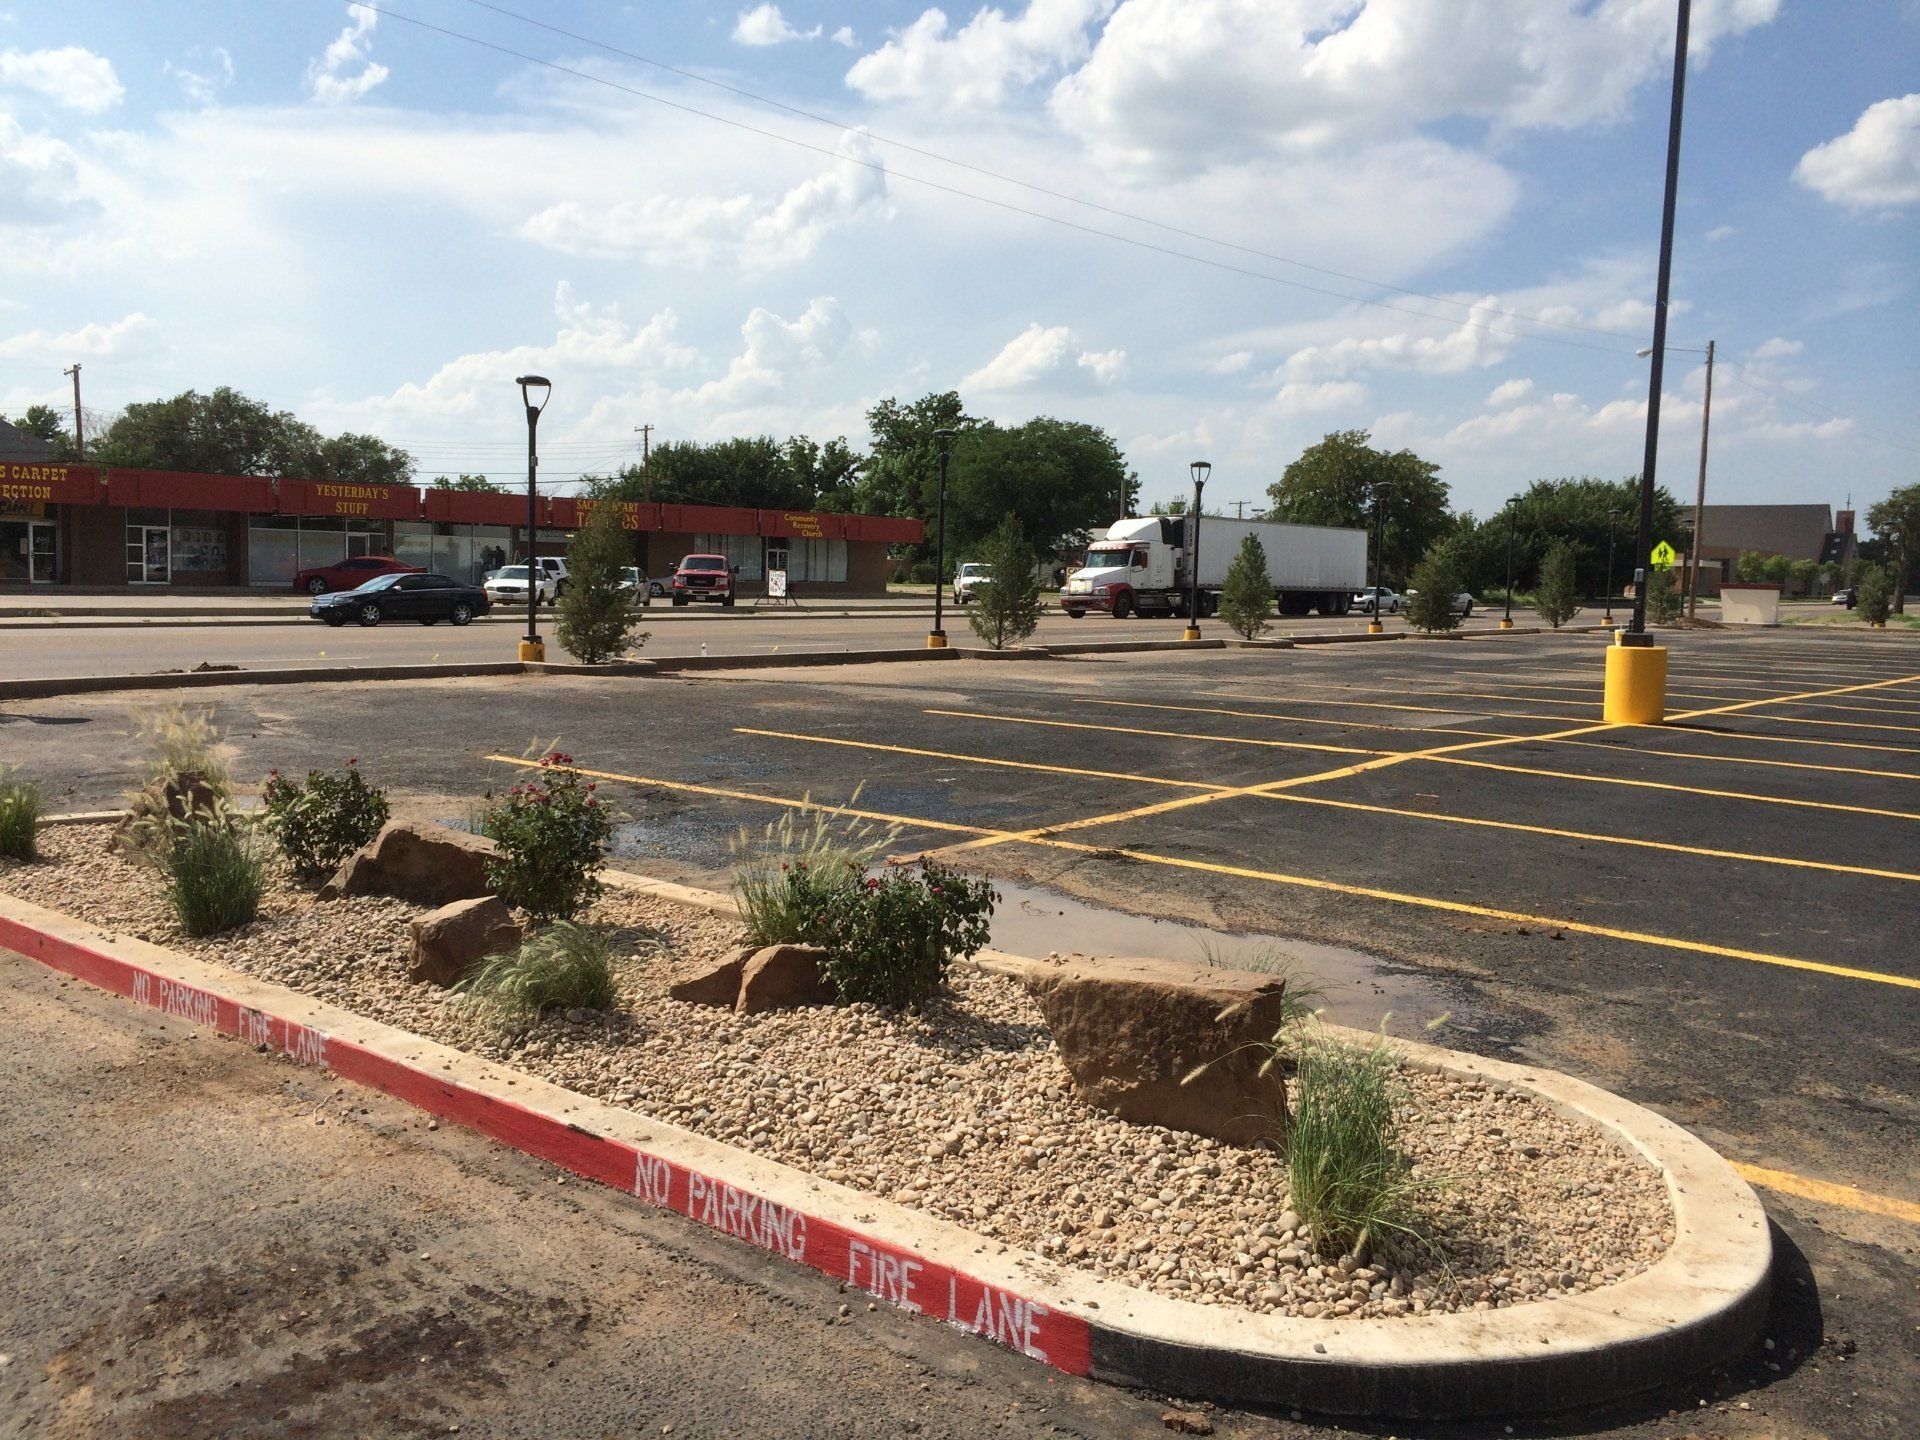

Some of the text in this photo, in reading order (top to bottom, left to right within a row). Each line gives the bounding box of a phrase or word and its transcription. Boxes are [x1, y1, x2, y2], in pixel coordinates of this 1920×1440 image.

[12, 466, 68, 481] CARPET
[316, 484, 389, 500] YESTERDAY'S
[335, 501, 369, 514] STUFF
[576, 511, 638, 530] TAOS
[784, 513, 818, 524] Community
[792, 521, 820, 532] Recovery
[801, 529, 823, 538] Church
[133, 970, 330, 1068] NO PARKING FIRE LANE
[634, 1151, 1049, 1361] NO PARKING FIRE LANE
